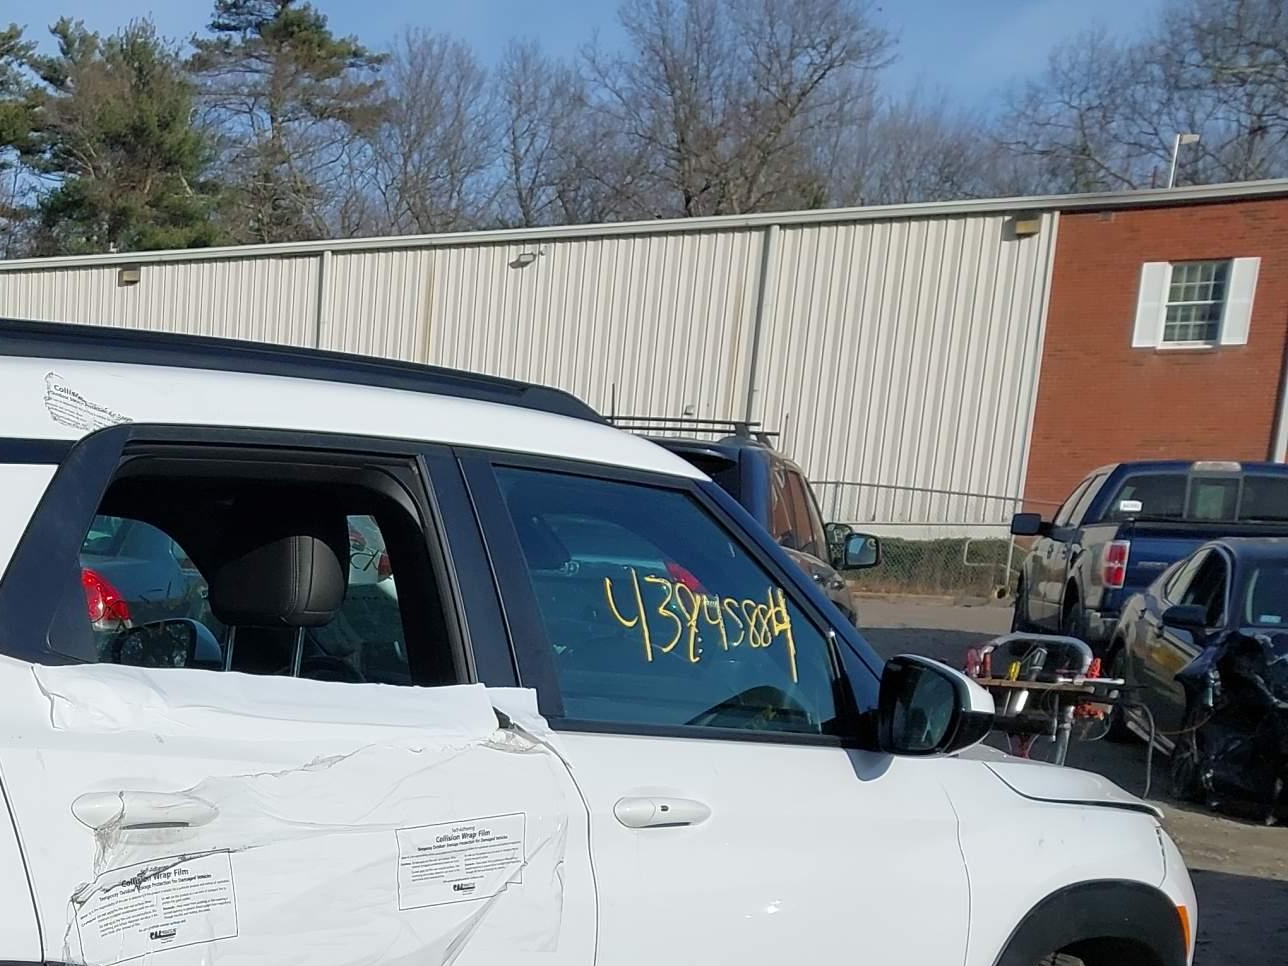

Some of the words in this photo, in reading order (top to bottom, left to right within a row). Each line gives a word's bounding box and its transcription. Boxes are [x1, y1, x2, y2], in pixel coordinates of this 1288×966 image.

[435, 834, 461, 843] Collision
[461, 831, 477, 840] Wrap
[153, 871, 173, 881] Wrap
[173, 867, 190, 876] Film
[177, 875, 197, 884] Damaged
